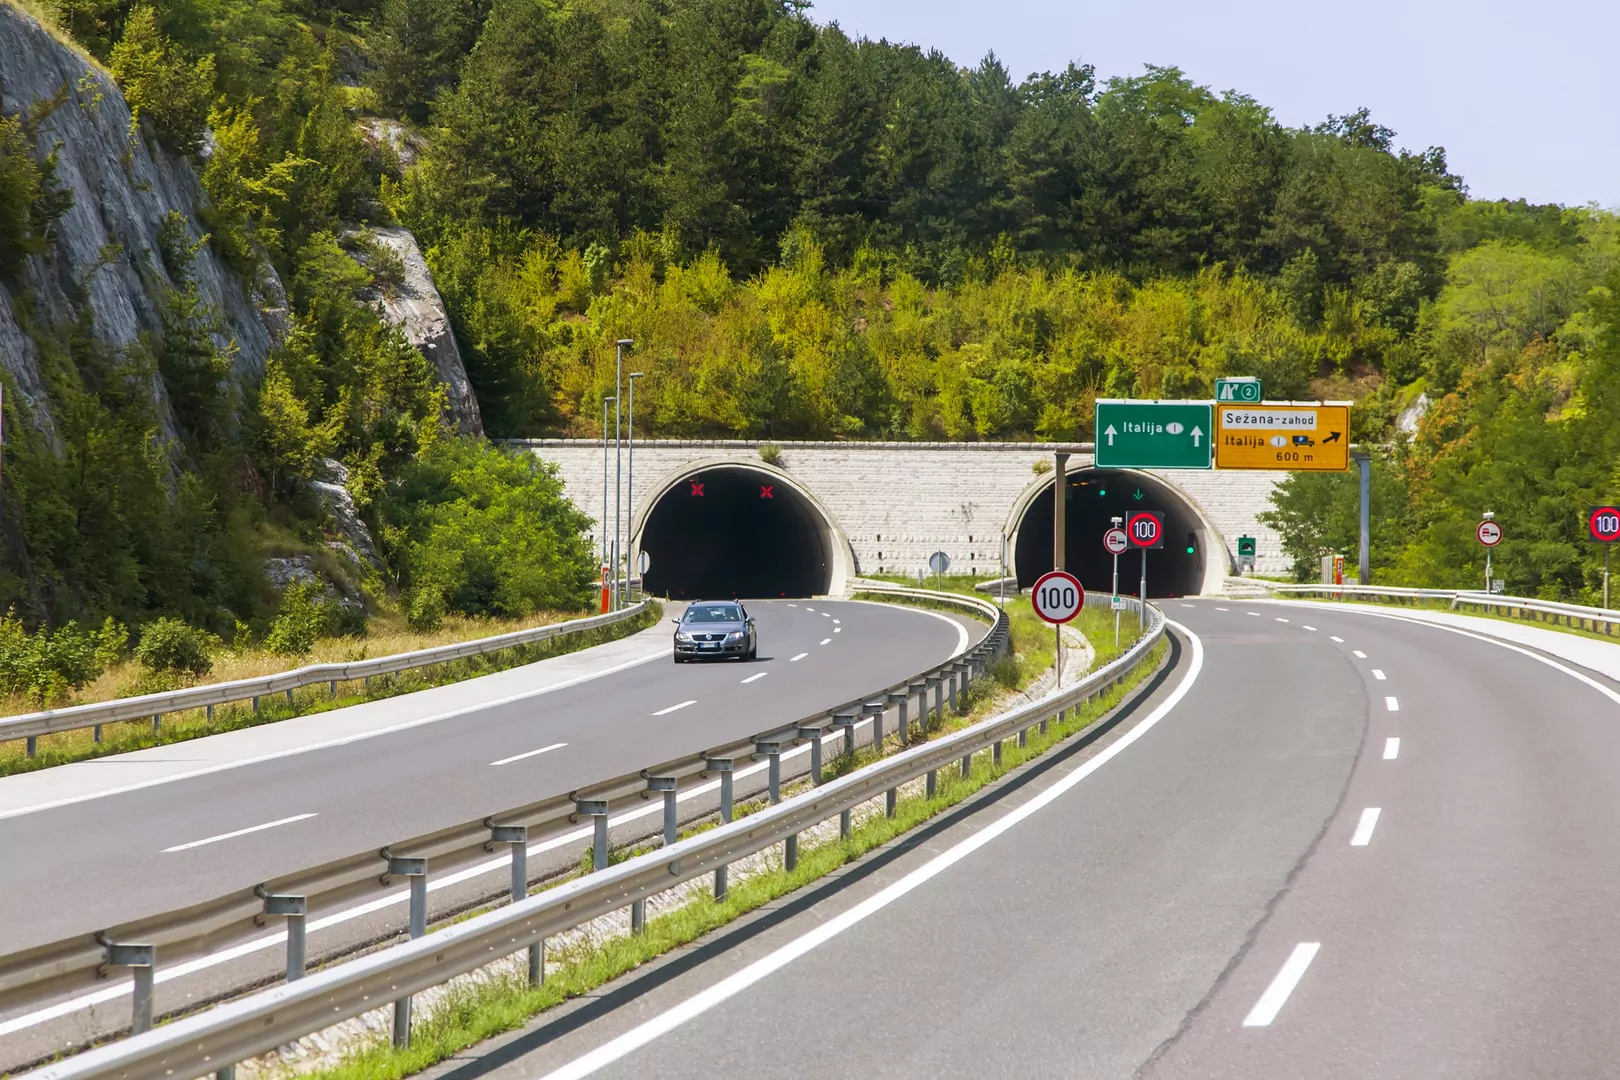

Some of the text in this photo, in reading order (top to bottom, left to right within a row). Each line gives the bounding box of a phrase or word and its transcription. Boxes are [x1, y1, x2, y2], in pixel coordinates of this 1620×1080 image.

[1246, 388, 1252, 396] 2
[1226, 413, 1314, 425] Sežana-zahod
[1123, 421, 1163, 435] Italija
[1225, 435, 1265, 448] Italija
[1276, 452, 1299, 461] 600
[1134, 521, 1156, 538] 100
[1596, 516, 1619, 532] 100
[1041, 587, 1075, 609] 100
